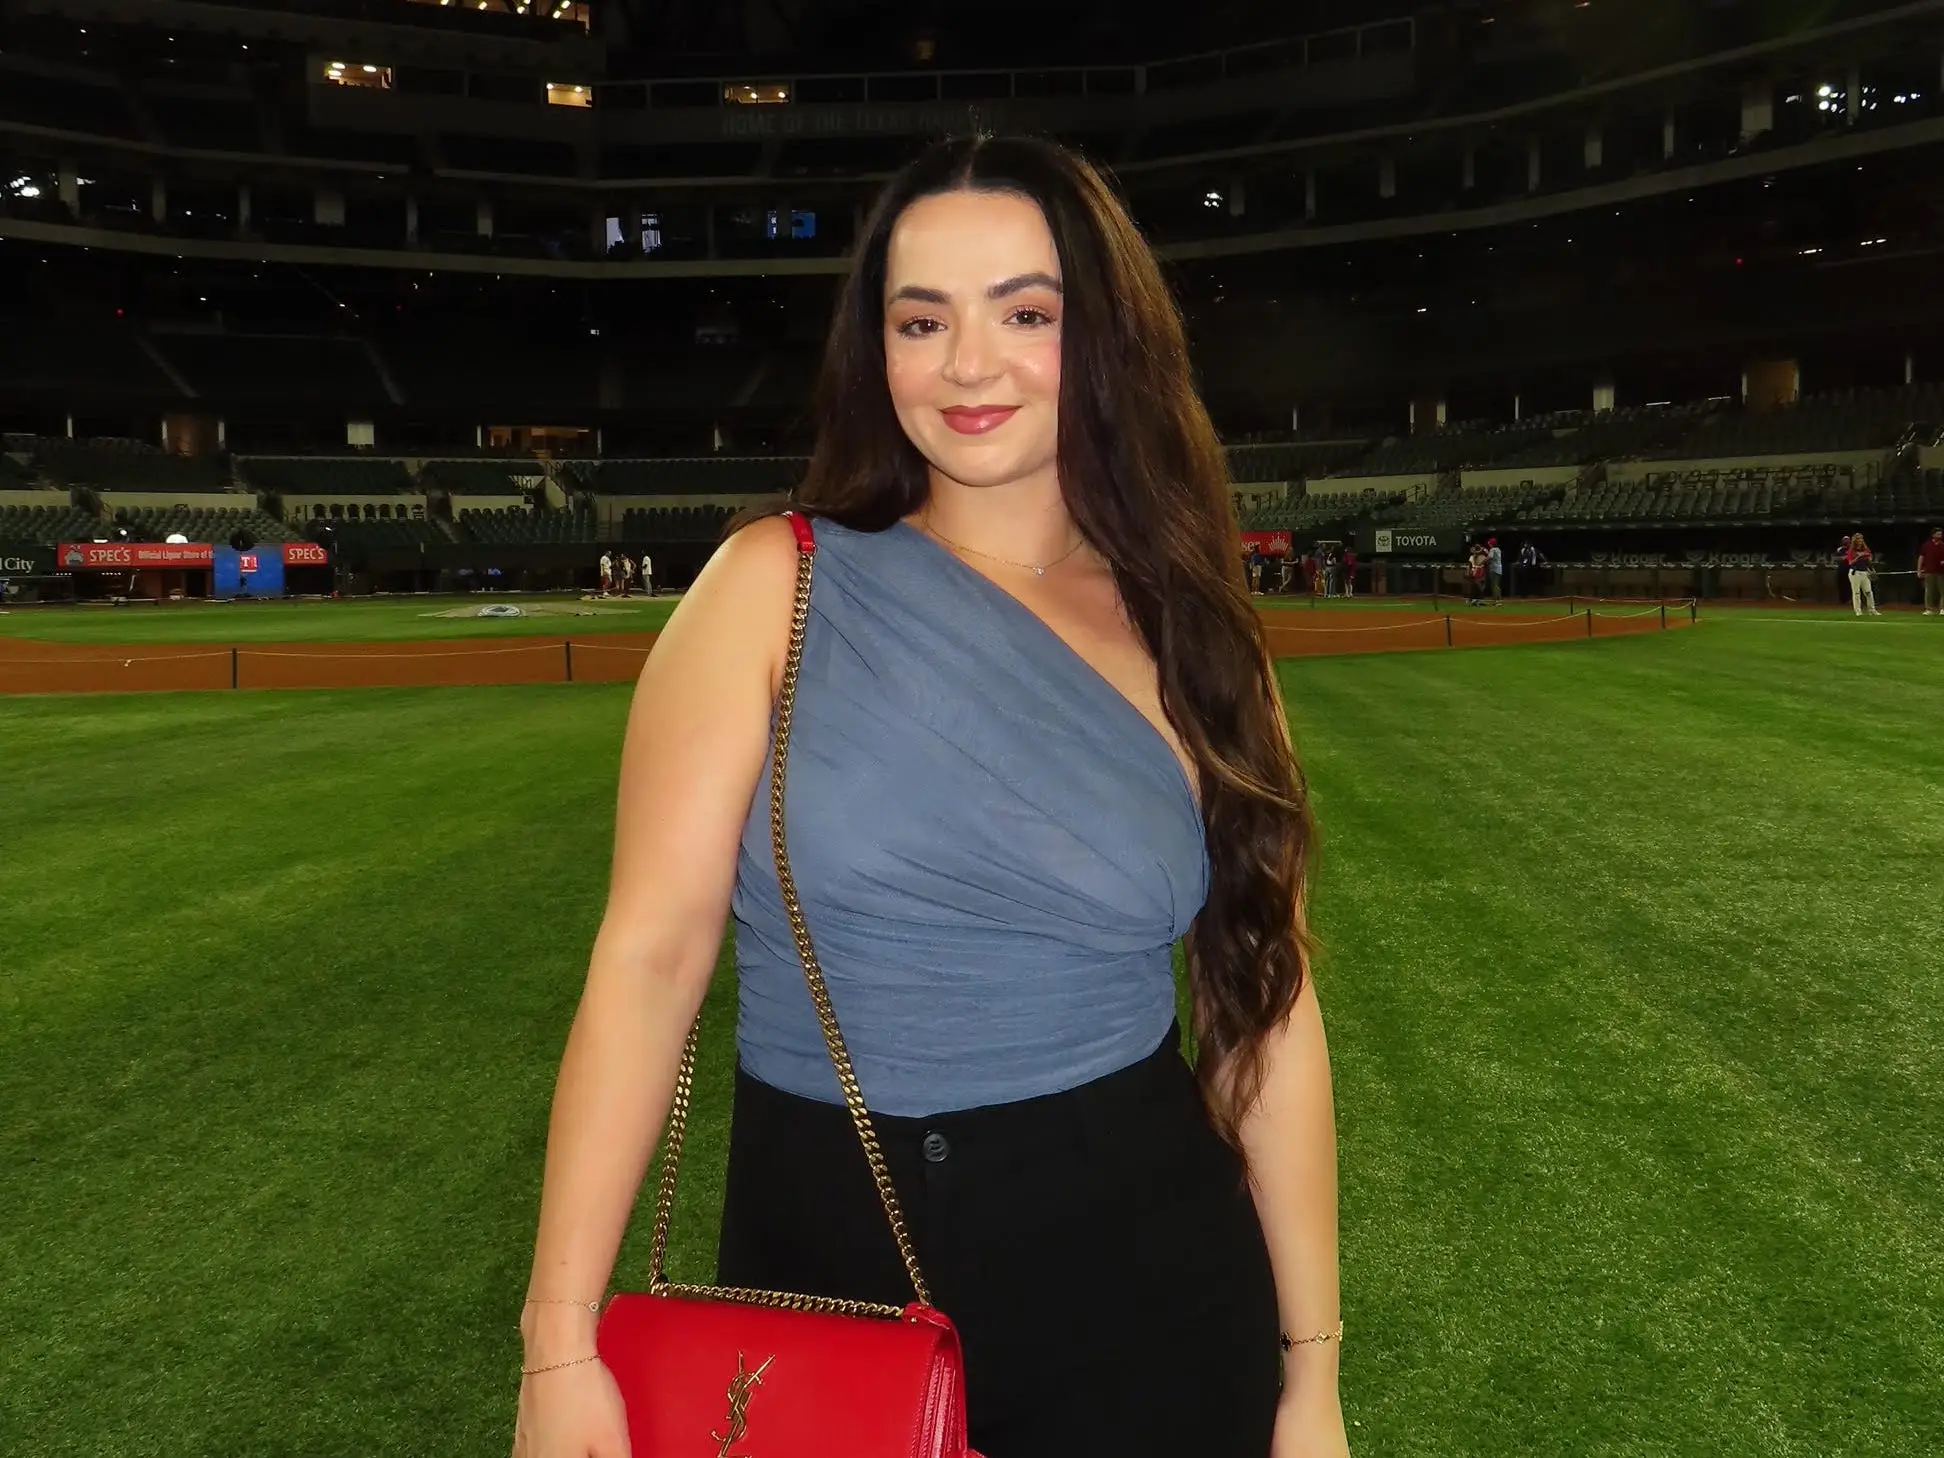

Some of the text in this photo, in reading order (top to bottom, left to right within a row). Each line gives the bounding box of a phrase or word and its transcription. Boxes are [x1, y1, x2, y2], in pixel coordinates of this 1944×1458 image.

[1396, 535, 1437, 547] TOYOTA
[89, 546, 132, 562] SPEC'S
[288, 545, 325, 560] SPEC'S
